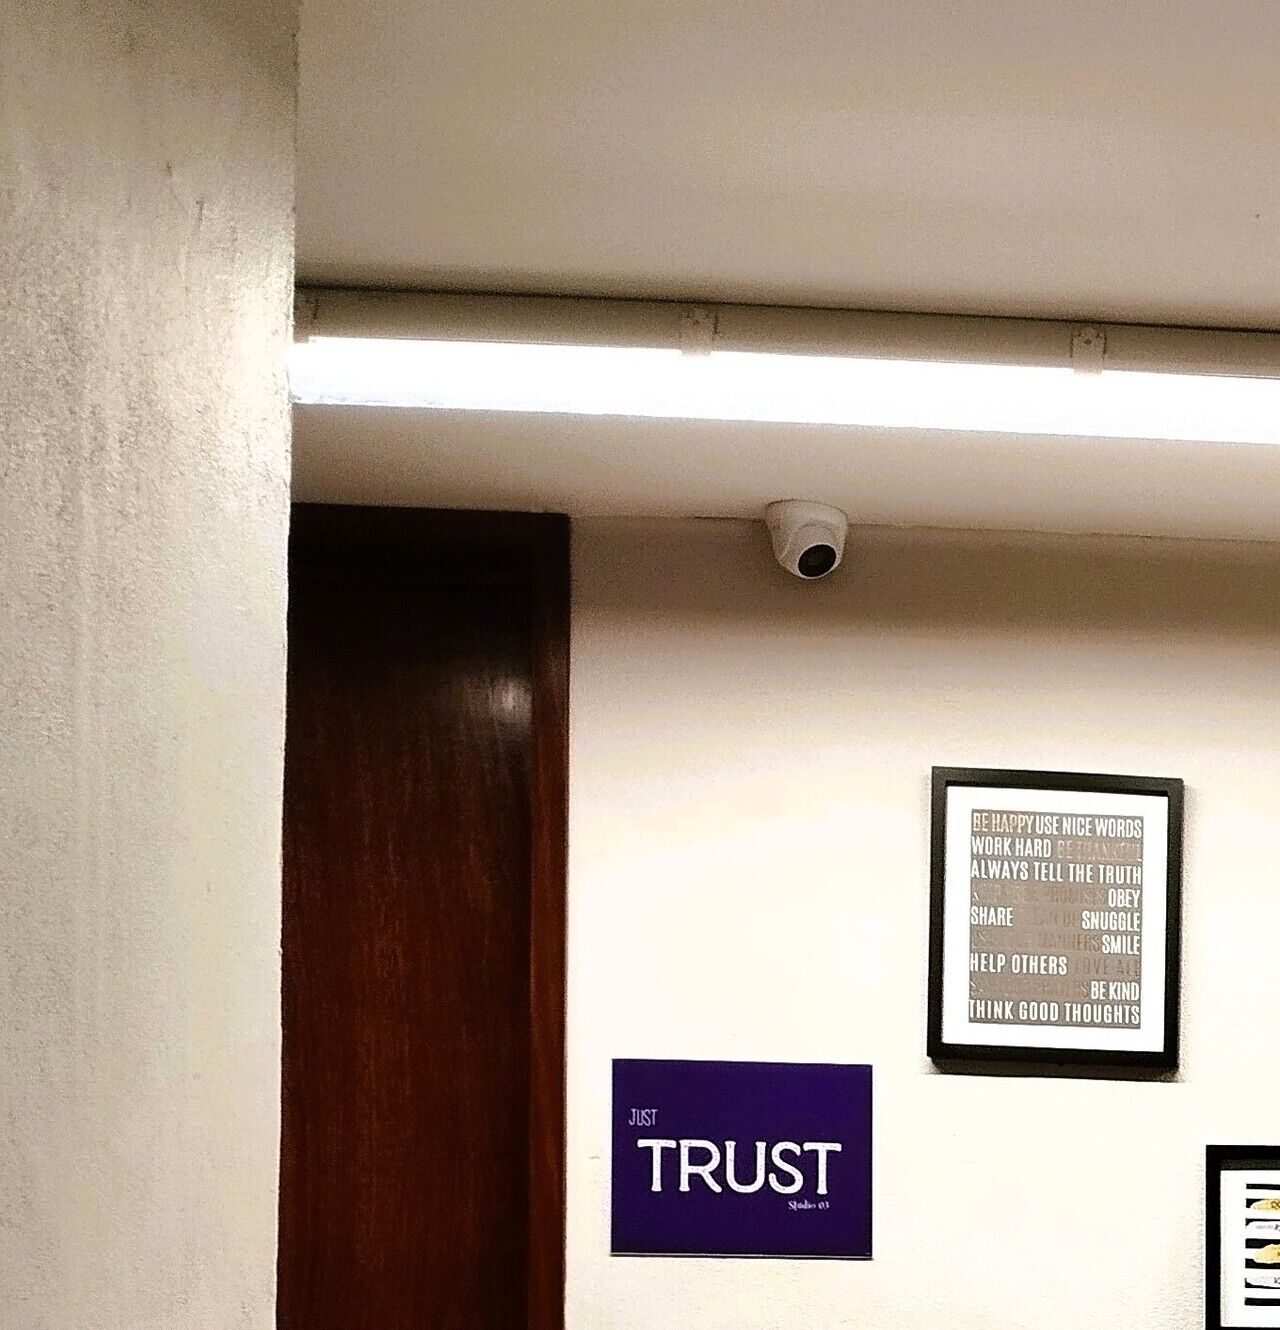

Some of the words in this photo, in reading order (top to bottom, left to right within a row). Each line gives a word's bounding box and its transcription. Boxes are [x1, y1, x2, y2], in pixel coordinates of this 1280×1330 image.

[973, 812, 989, 832] BE
[992, 813, 1034, 835] HAPPY
[1035, 815, 1060, 836] USE
[1062, 816, 1092, 837] NICE
[1094, 818, 1143, 839] WORDS
[971, 835, 1012, 857] WORK
[1015, 837, 1051, 858] HARD
[971, 859, 1029, 880] ALWAYS
[1033, 861, 1064, 882] TELL
[1068, 863, 1094, 884] THE
[1098, 864, 1142, 885] TRUTH
[1108, 888, 1141, 908] OBEY
[970, 905, 1014, 927] SHARE
[1081, 910, 1141, 932] SNUGGLE
[1101, 934, 1141, 955] SMILE
[969, 952, 1006, 973] HELP
[1011, 954, 1068, 976] OTHERS
[1091, 980, 1107, 1000] BE
[1108, 981, 1140, 1001] KIND
[968, 998, 1014, 1020] THINK
[1018, 1001, 1059, 1022] GOOD
[1064, 1002, 1140, 1025] THOUGHTS
[628, 1107, 658, 1126] JUST
[637, 1138, 842, 1195] TRUST
